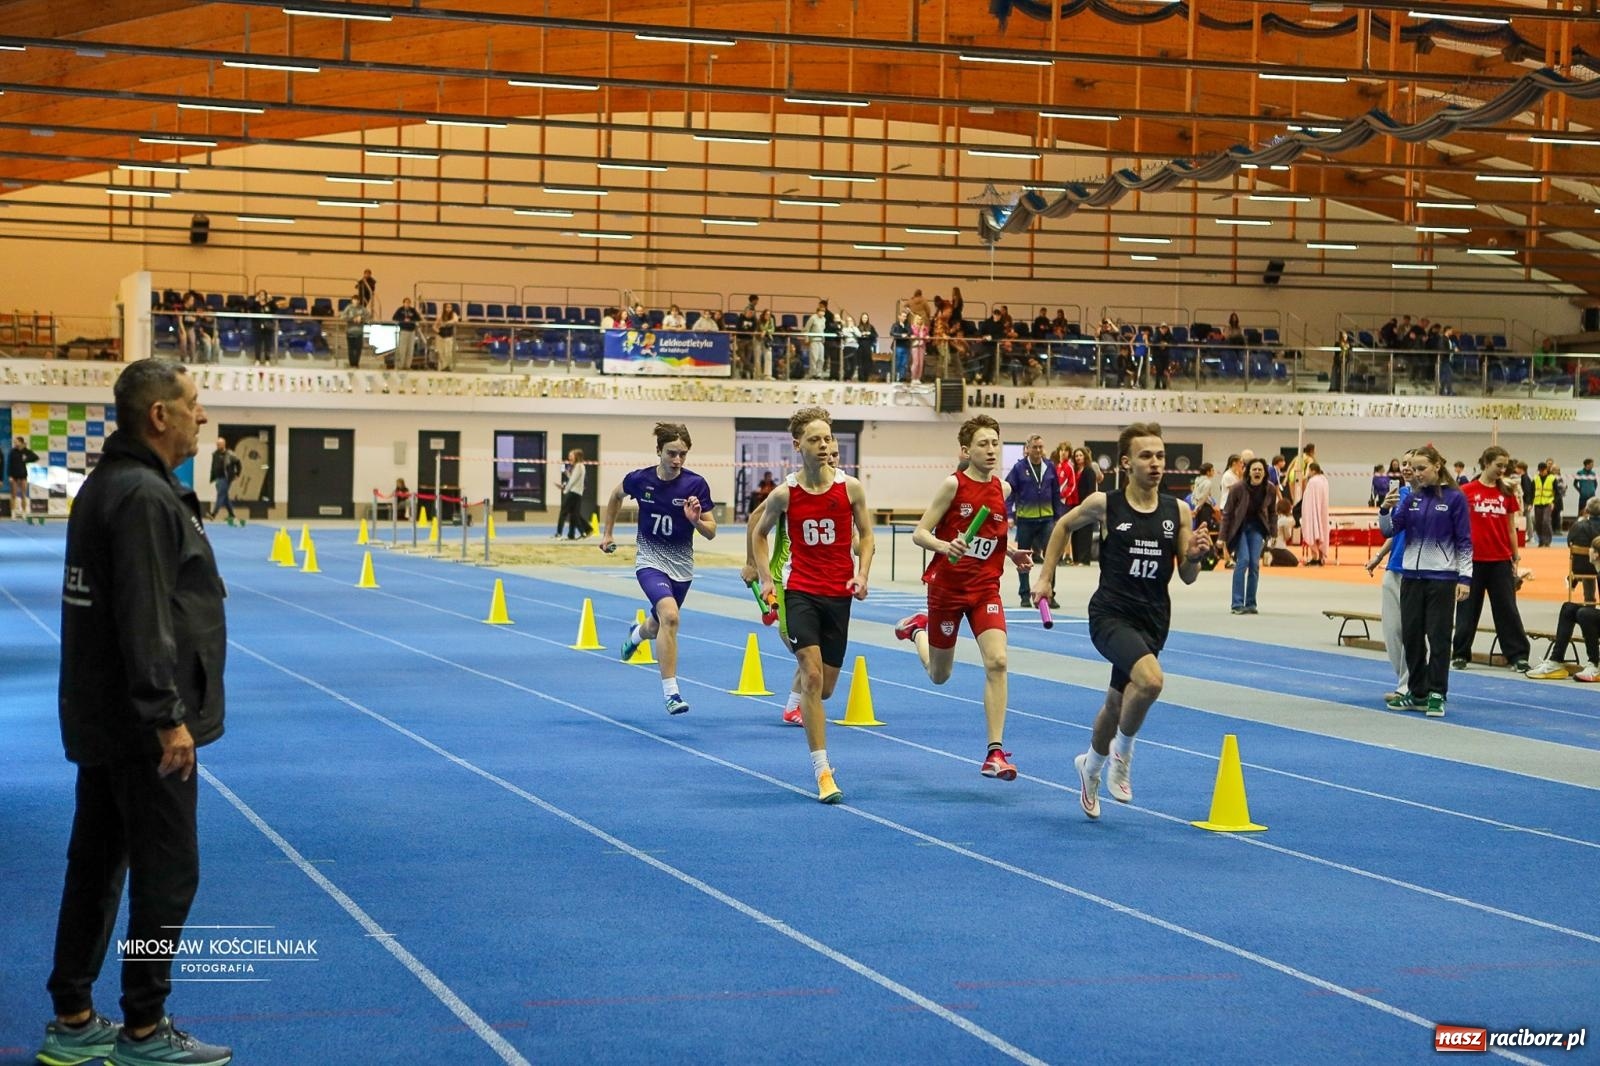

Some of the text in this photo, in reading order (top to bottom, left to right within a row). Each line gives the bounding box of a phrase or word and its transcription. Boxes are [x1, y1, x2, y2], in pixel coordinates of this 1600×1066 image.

[659, 338, 714, 349] Lekkoatletyka
[651, 513, 673, 536] 70
[802, 518, 836, 546] 63
[1116, 522, 1133, 531] 4F
[973, 538, 992, 557] 19
[1129, 558, 1159, 579] 412
